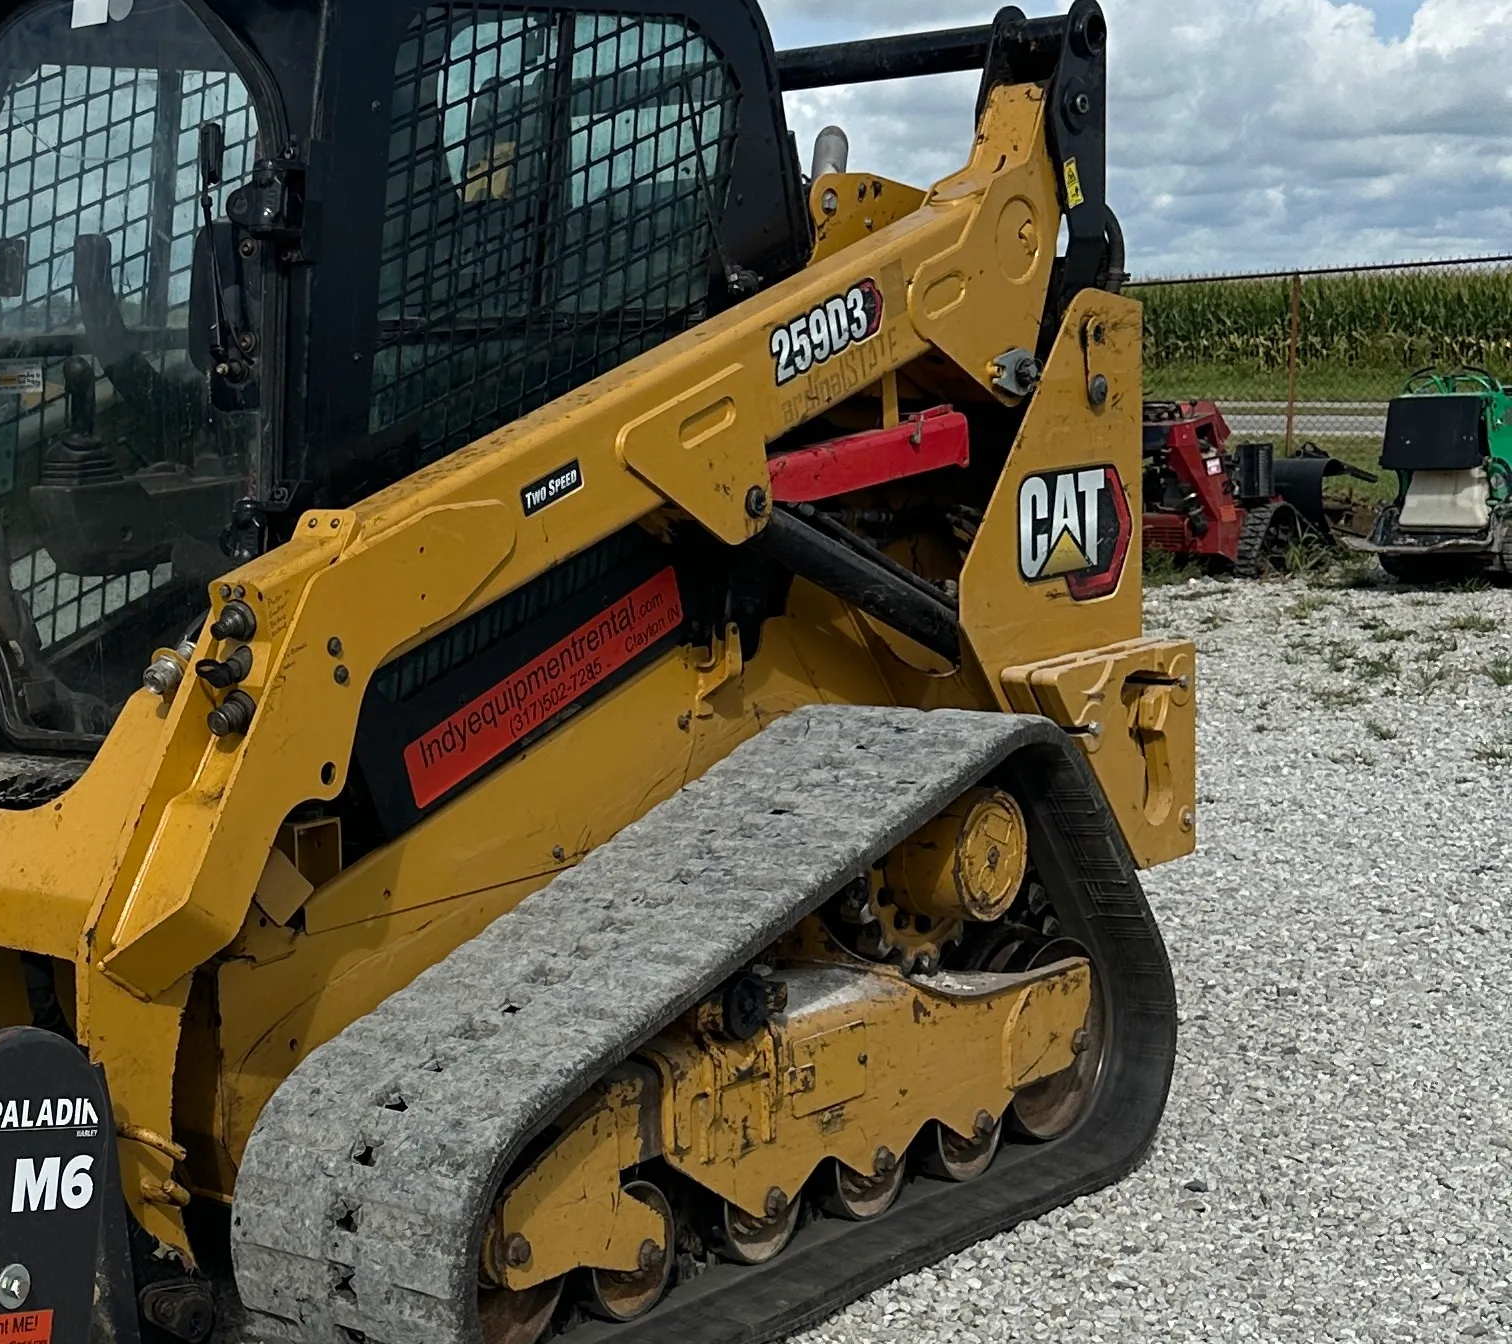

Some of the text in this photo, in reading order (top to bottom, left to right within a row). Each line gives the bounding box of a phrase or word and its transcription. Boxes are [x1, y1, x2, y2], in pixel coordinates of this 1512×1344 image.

[771, 288, 868, 383] 259D3
[1020, 468, 1105, 578] CAT
[509, 604, 680, 738] (317)502-7285 Clayton IN
[11, 1154, 95, 1213] M6
[12, 1315, 39, 1333] ME!
